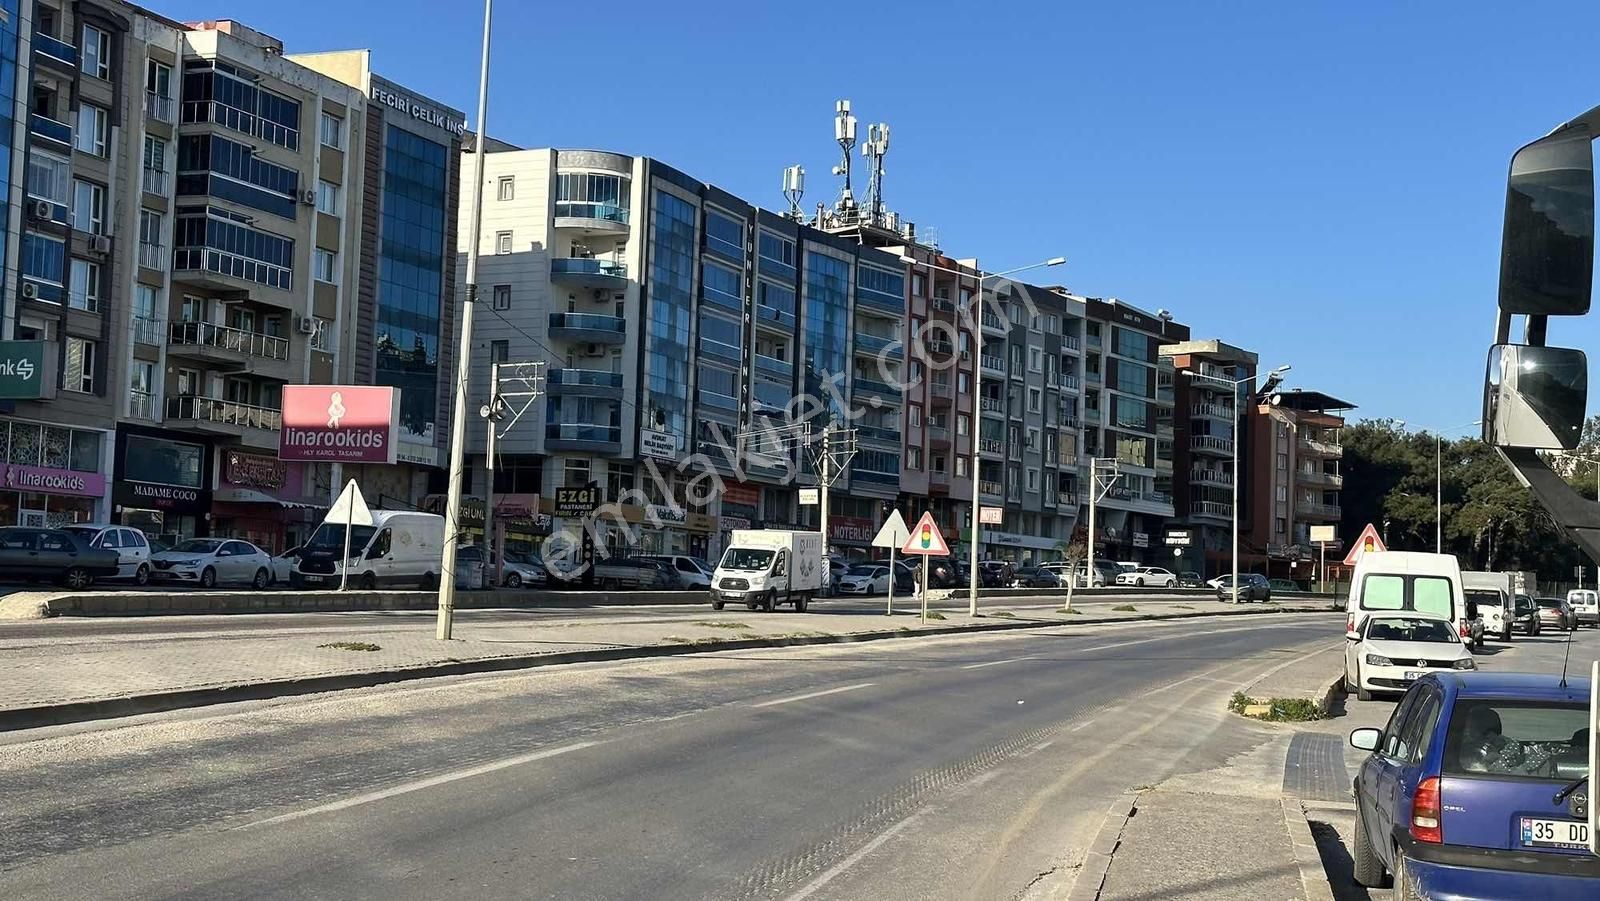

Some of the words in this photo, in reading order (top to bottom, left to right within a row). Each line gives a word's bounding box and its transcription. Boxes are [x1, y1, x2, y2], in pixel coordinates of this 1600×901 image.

[285, 427, 384, 448] linarookids
[19, 470, 85, 490] linarookids
[134, 485, 172, 498] MADAME
[173, 489, 197, 501] COCO
[558, 488, 595, 503] EZGİ
[834, 525, 873, 541] NOTERLİĞİ
[1535, 823, 1554, 839] 35
[1569, 824, 1588, 842] DD
